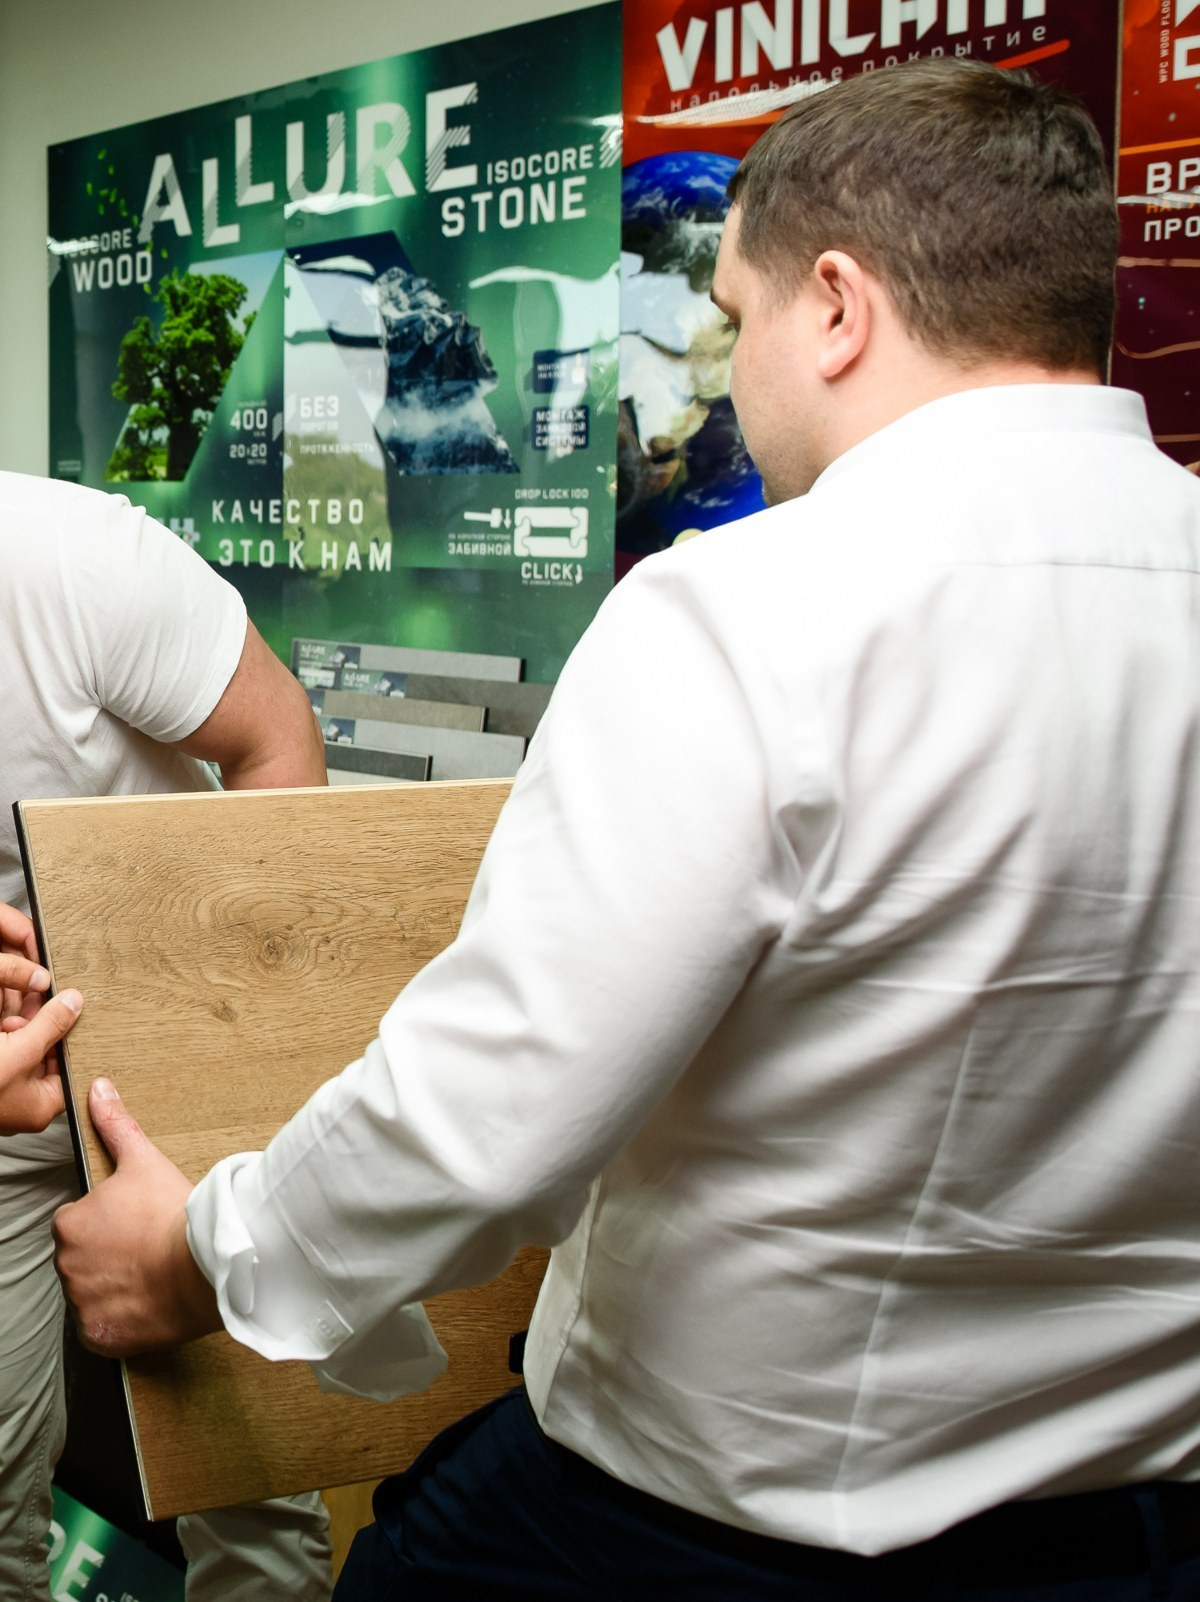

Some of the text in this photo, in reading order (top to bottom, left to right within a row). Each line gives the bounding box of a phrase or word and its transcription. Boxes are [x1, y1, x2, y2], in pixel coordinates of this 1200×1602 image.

[1159, 29, 1171, 58] WOOD
[138, 82, 478, 247] ALLURE
[487, 144, 594, 185] ISOCORE
[442, 176, 587, 237] STONE
[73, 251, 152, 293] WOOD
[230, 408, 267, 430] 400
[300, 395, 339, 418] БЕЗ
[515, 489, 541, 499] DROP
[543, 489, 569, 499] LOCK
[212, 499, 364, 524] КАЧЕСТВО
[218, 539, 392, 572] ЭТО К НАМ
[448, 542, 511, 556] ЗАБИВНОЙ
[521, 562, 573, 580] CLICK
